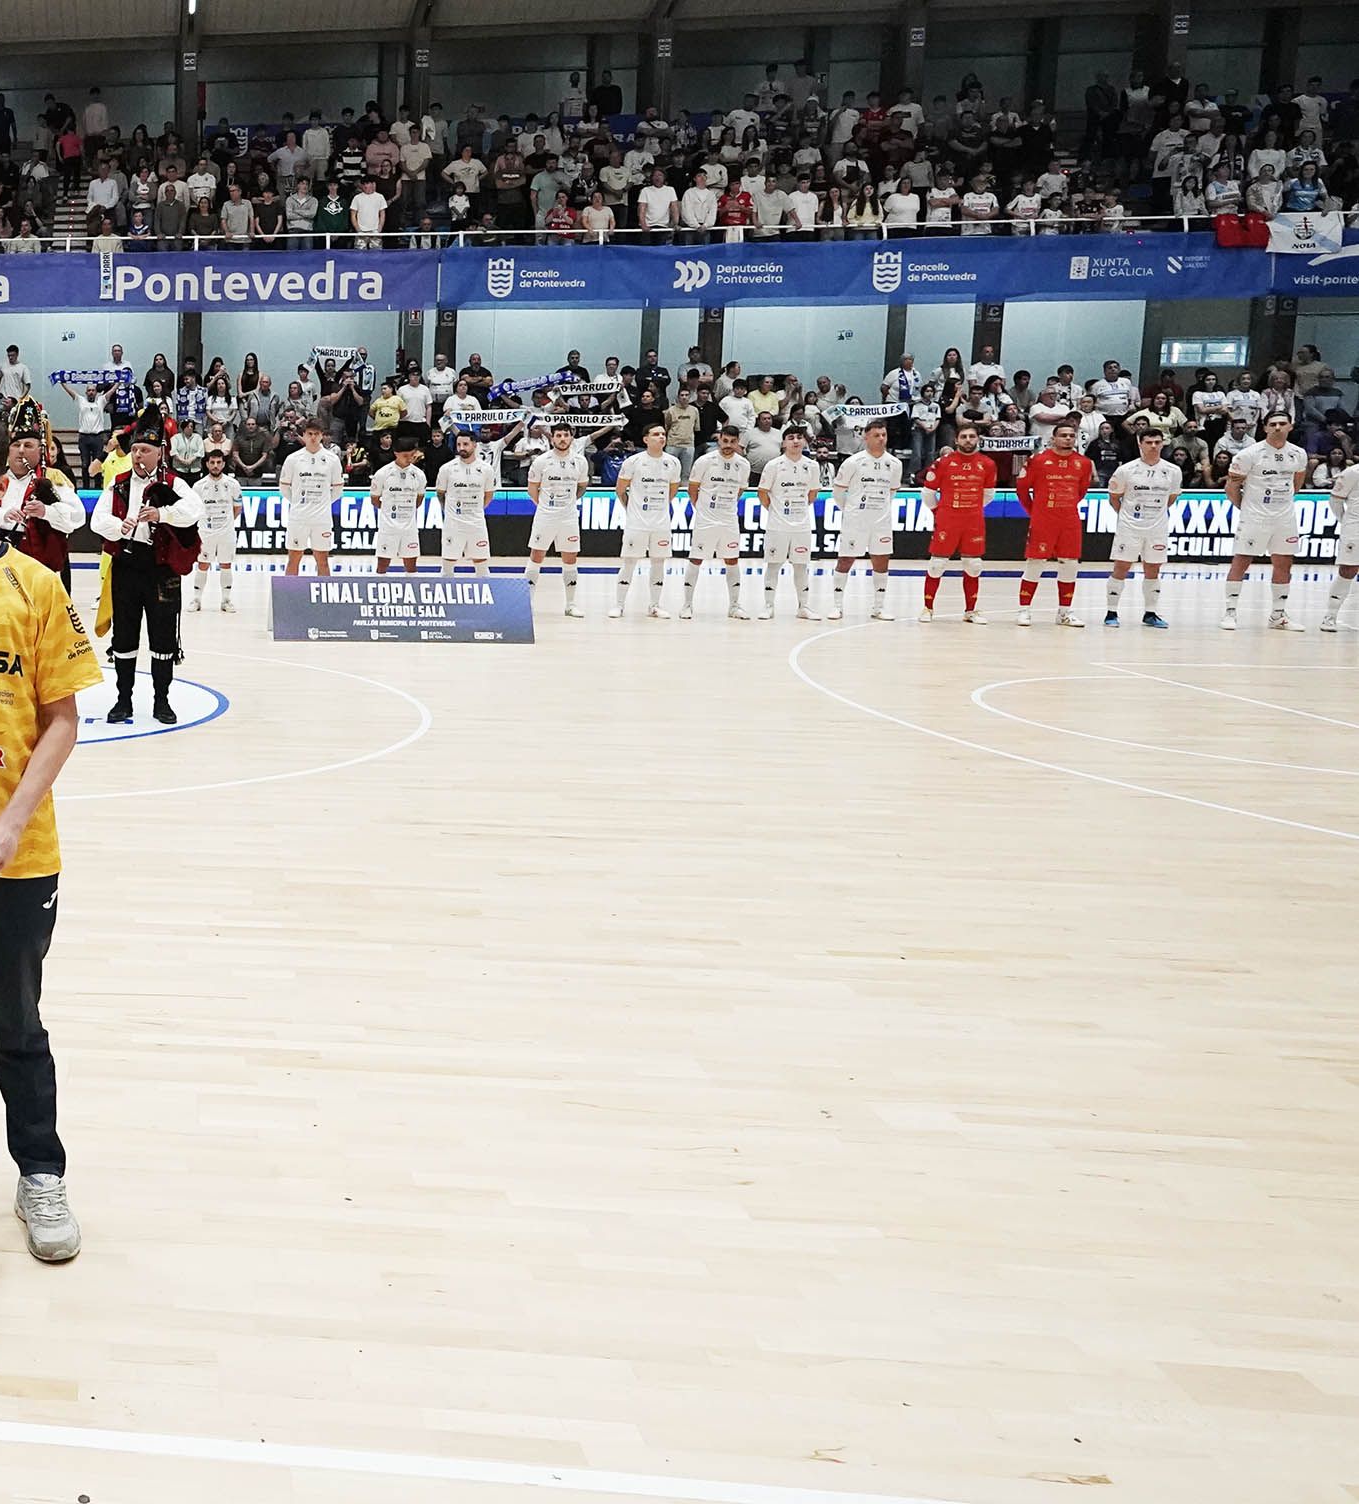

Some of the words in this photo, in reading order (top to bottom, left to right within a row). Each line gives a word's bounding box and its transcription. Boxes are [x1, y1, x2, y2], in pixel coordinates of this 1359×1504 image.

[908, 263, 950, 272] Concello
[1092, 258, 1130, 267] XUNTA
[716, 262, 783, 276] Deputación
[1091, 267, 1106, 277] DE
[1108, 266, 1154, 276] GALICIA
[520, 270, 560, 279] Concello
[716, 274, 783, 284] Pontevedra
[908, 272, 918, 281] de
[921, 272, 976, 282] Pontevedra
[115, 260, 384, 302] Pontevedra
[520, 279, 530, 288] de
[531, 279, 586, 288] Pontevedra
[570, 382, 614, 394] PARRULO
[849, 406, 889, 416] PARRULO
[464, 412, 504, 422] PARRULO
[544, 415, 551, 424] O
[554, 415, 598, 424] PARRULO
[600, 415, 613, 424] FS
[251, 531, 273, 549] DE
[310, 582, 364, 604] FINAL
[367, 582, 417, 604] COPA
[420, 582, 494, 604] GALICIA
[361, 605, 374, 617] DE
[376, 602, 416, 617] FÚTBOL
[418, 605, 446, 618] SALA
[68, 652, 76, 660] de
